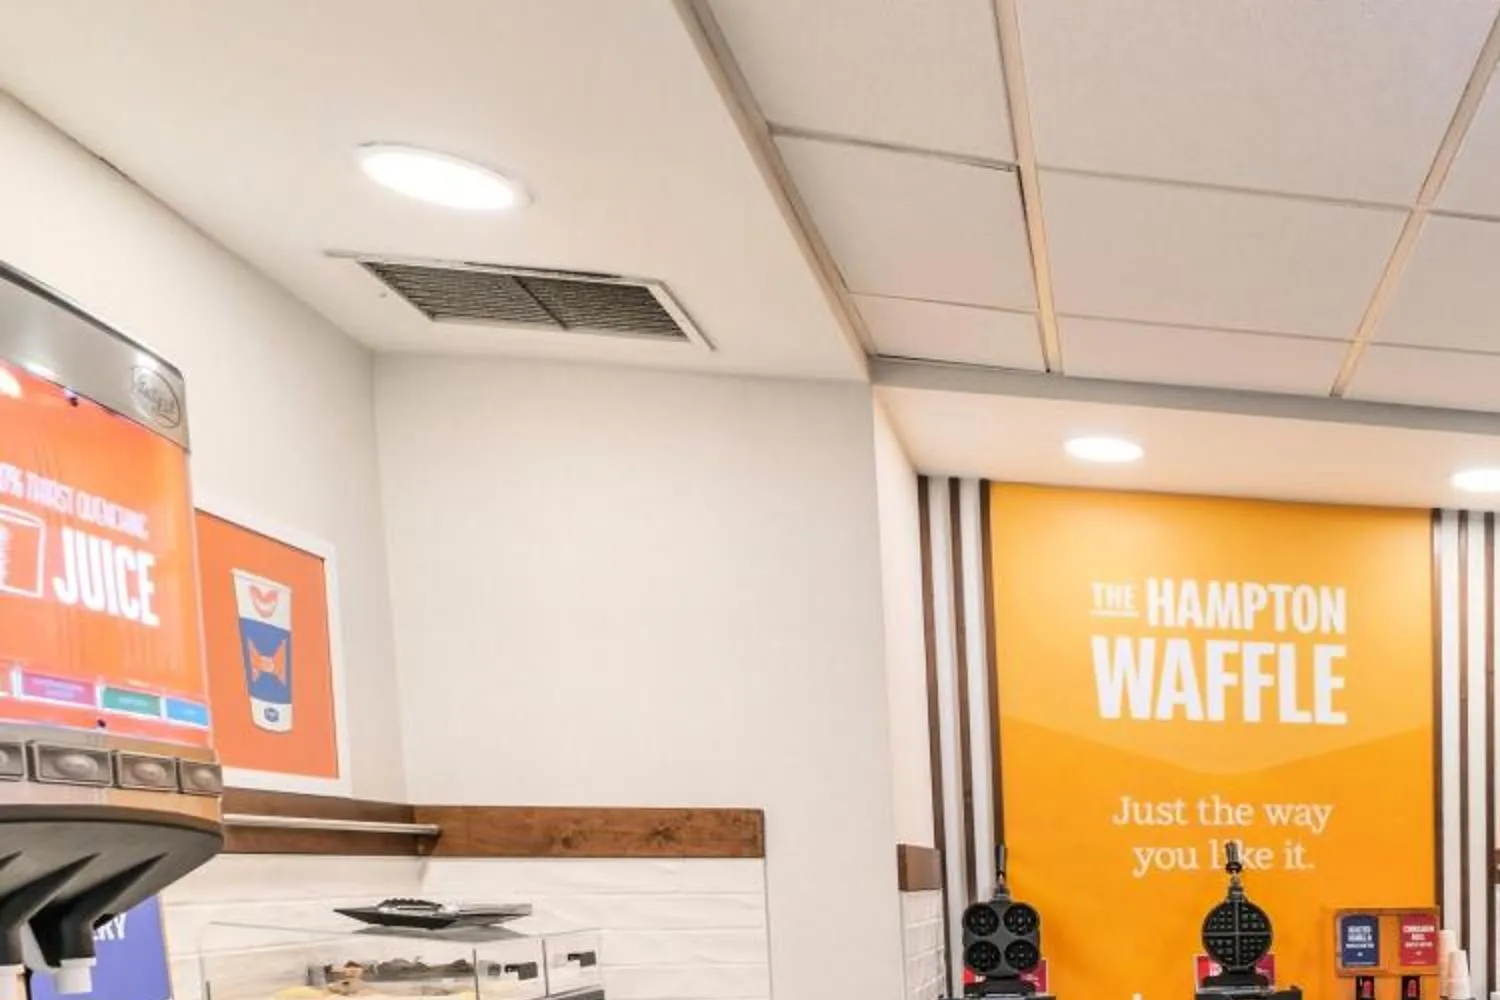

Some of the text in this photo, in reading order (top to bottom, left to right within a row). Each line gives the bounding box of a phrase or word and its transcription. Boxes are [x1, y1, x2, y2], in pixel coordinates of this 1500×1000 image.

[26, 471, 74, 516] THIRST
[52, 525, 160, 627] JUICE
[1091, 577, 1346, 634] THE HAMPTON
[1091, 635, 1348, 726] WAFFLE
[1112, 795, 1334, 834] Just the way
[1132, 838, 1315, 879] you lke it.
